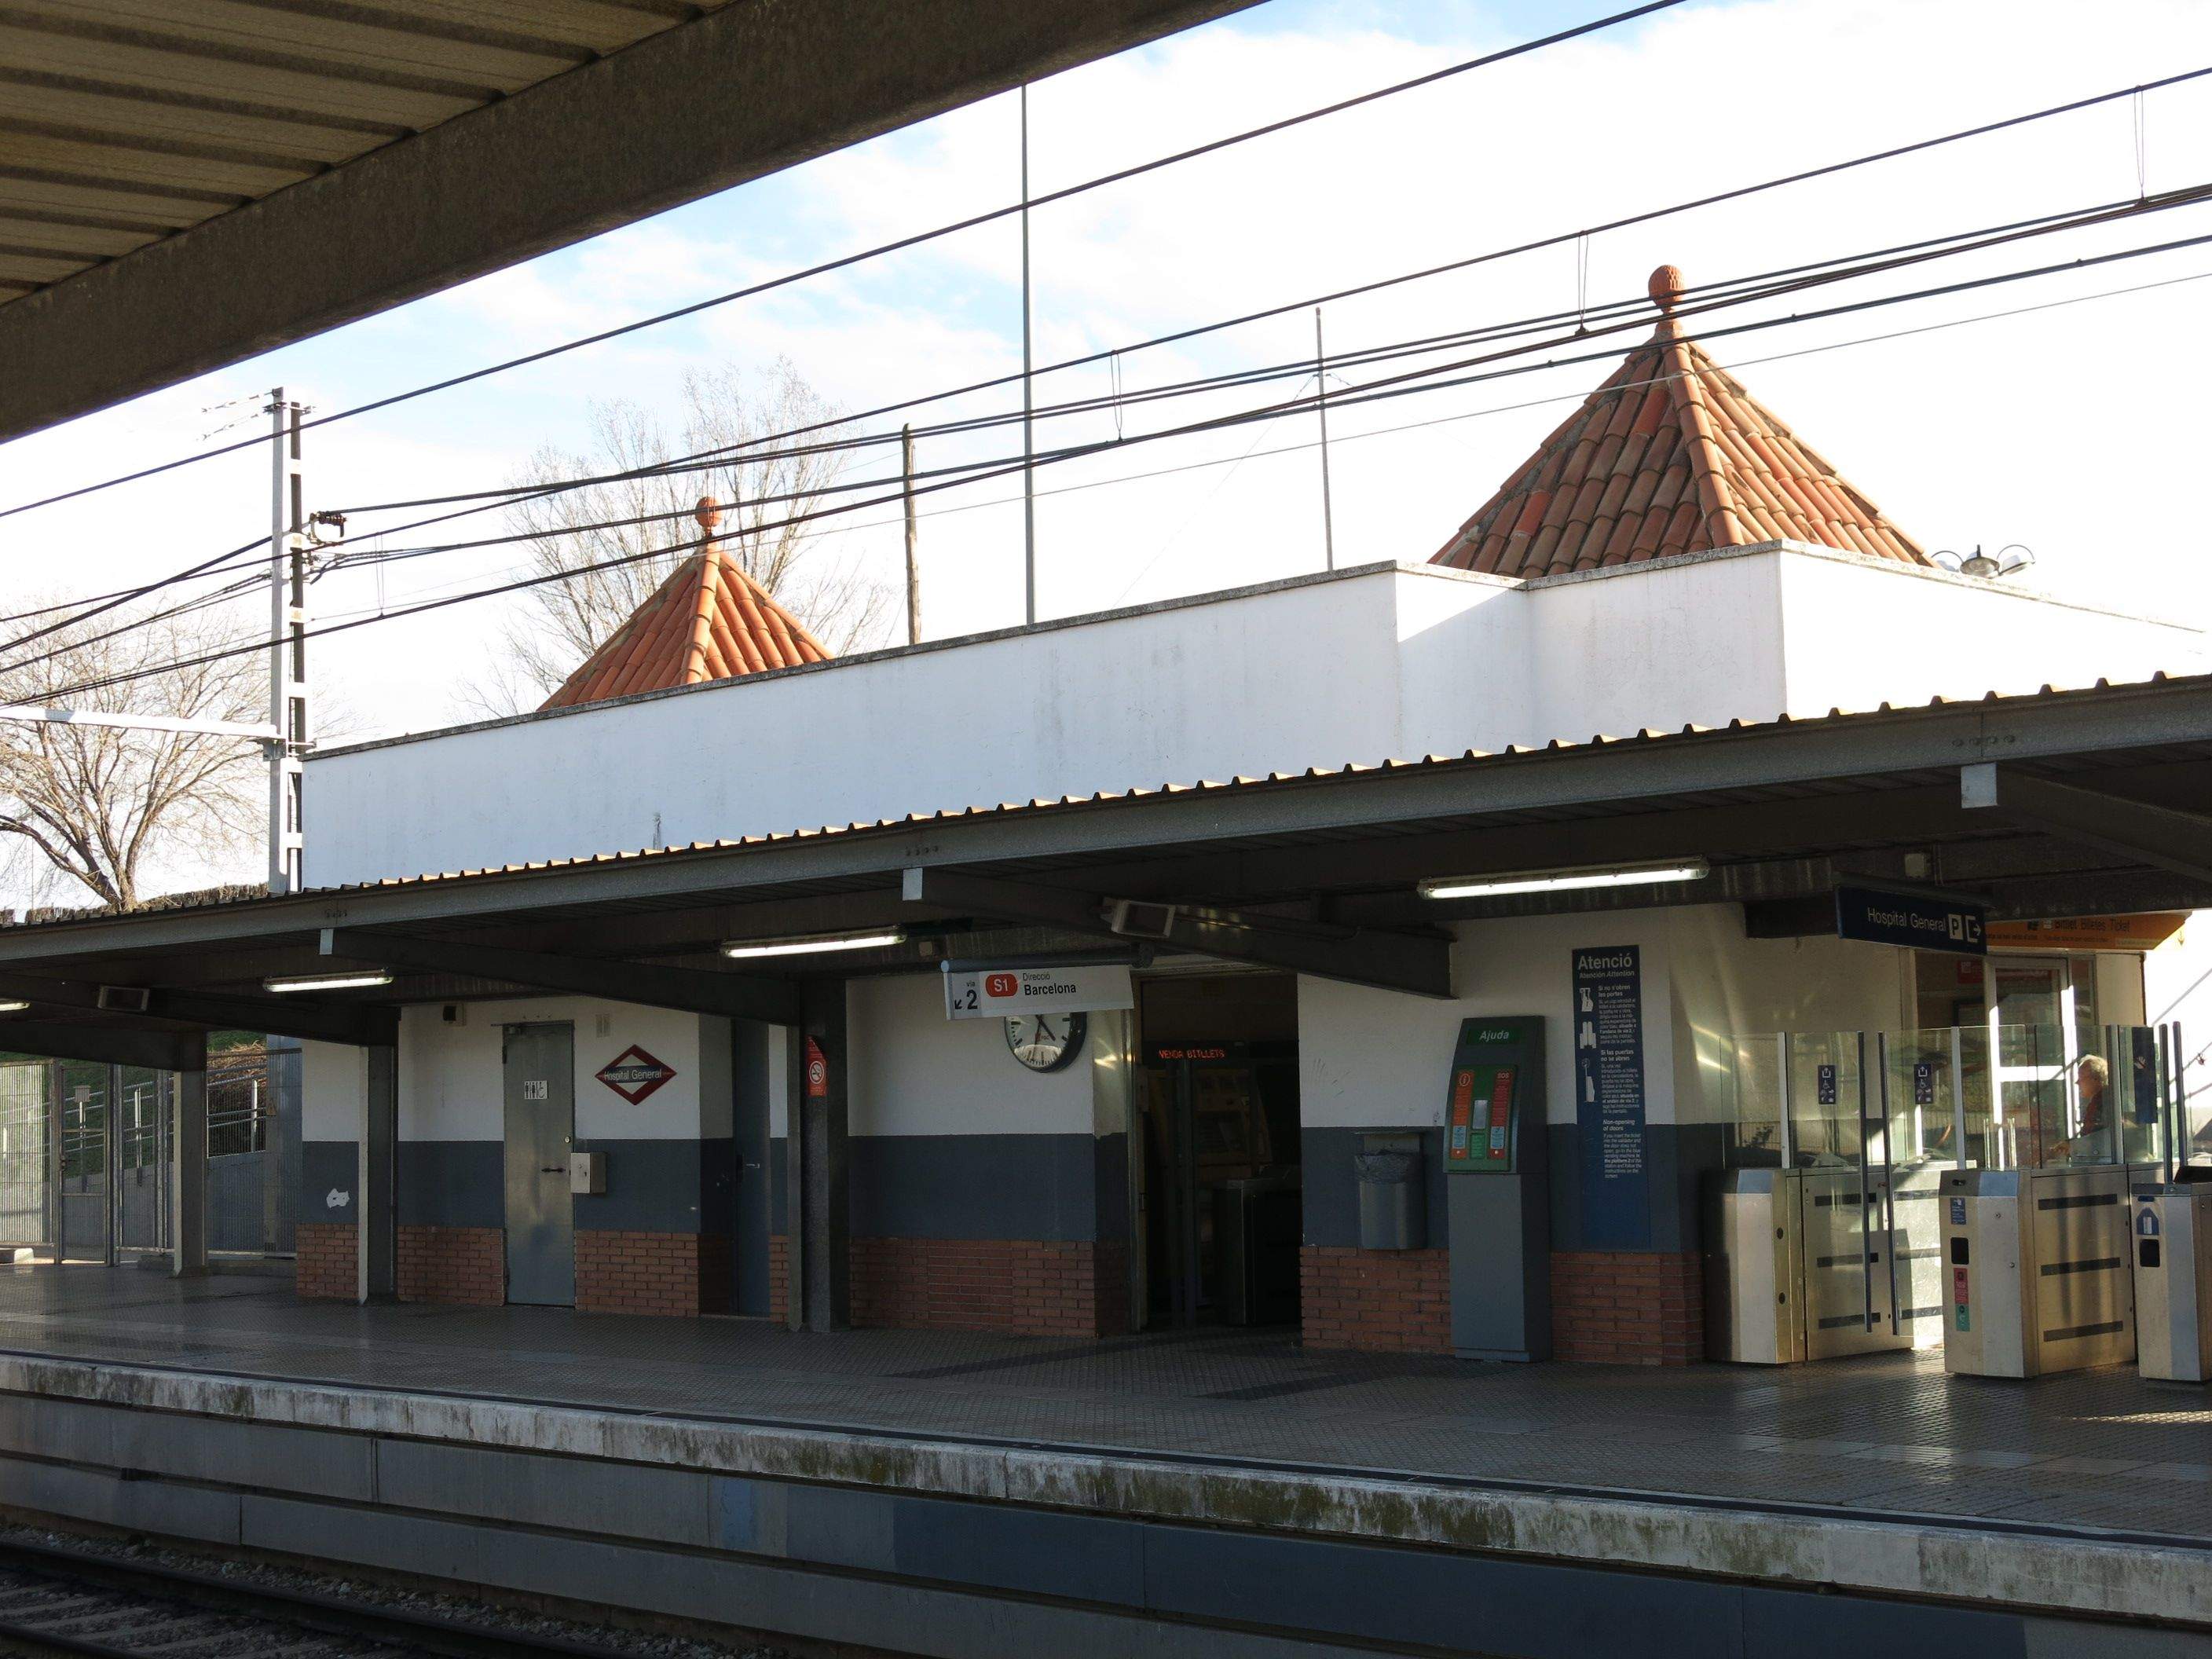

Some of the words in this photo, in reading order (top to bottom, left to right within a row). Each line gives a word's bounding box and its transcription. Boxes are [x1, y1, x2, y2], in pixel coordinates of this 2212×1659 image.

[1867, 906, 1907, 928] Hospital
[1910, 913, 1946, 932] General
[1578, 953, 1632, 970] Atenció
[1023, 972, 1050, 981] Direcció
[1579, 971, 1606, 980] Atención
[994, 979, 1009, 992] S1
[1024, 982, 1077, 996] Barcelona
[966, 989, 978, 1010] 2
[1479, 1030, 1509, 1042] Ajuda
[1187, 1049, 1225, 1059] BITLLETS
[604, 1071, 629, 1082] Hospital
[632, 1068, 662, 1080] General
